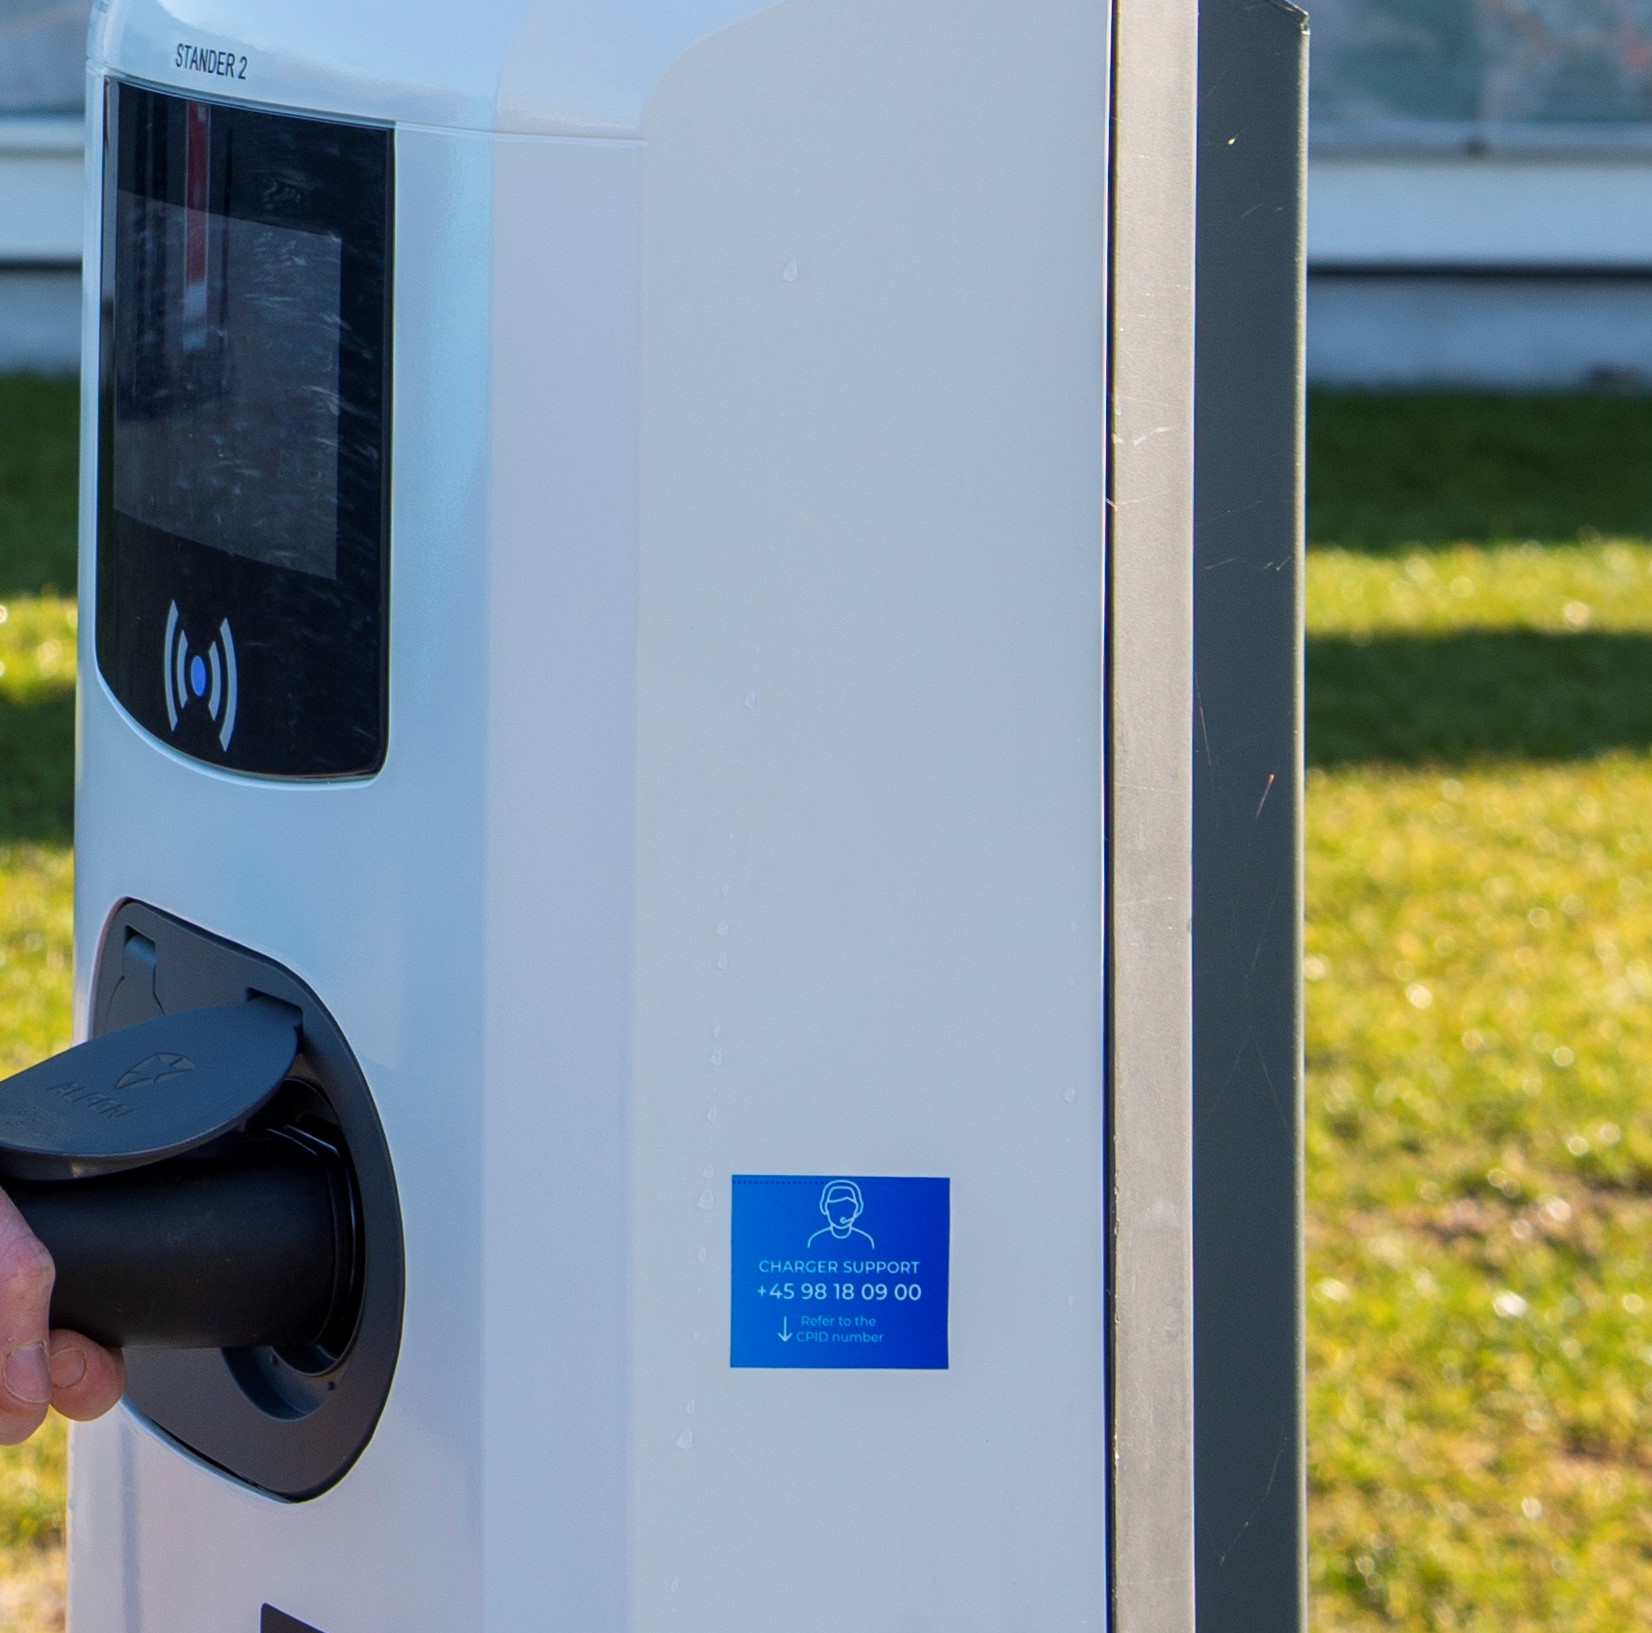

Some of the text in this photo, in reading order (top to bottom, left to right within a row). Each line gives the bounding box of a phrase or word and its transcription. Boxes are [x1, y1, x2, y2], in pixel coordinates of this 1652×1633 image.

[175, 43, 248, 80] STANDER 2
[759, 1260, 920, 1274] CHARGER SUPPORT
[757, 1283, 922, 1300] +45 98 18 09 00
[801, 1316, 876, 1328] Refer to the
[796, 1331, 884, 1343] CPID number
